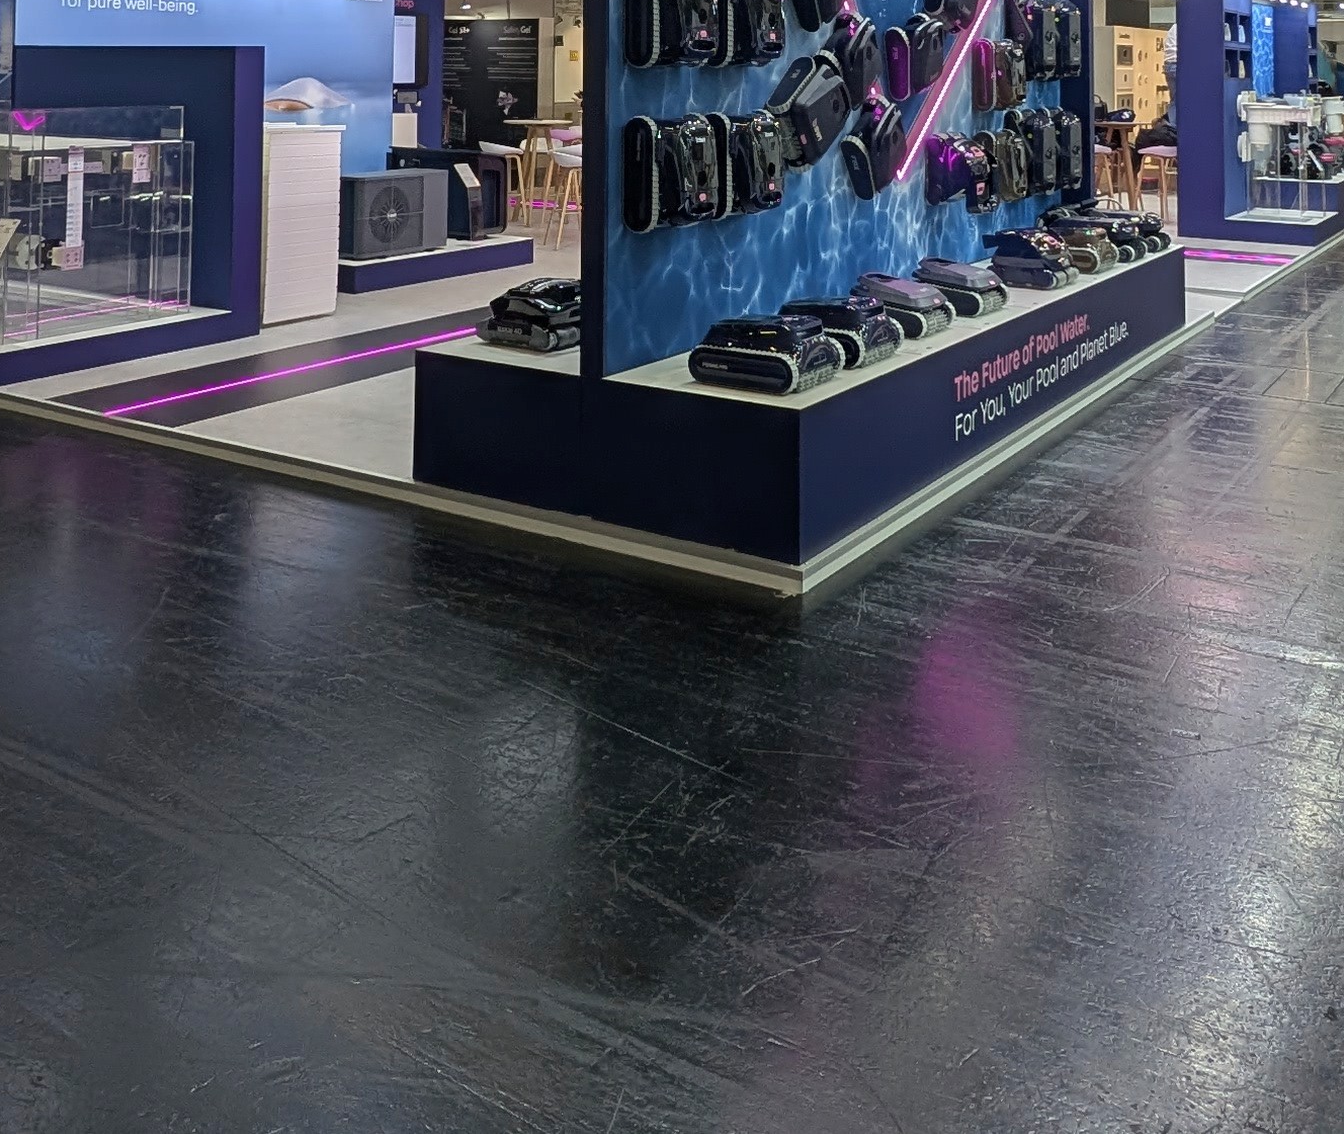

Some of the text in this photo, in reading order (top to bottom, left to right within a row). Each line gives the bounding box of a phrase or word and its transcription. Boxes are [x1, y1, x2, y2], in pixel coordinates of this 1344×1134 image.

[954, 313, 1091, 402] The Future of Pool Water.
[955, 320, 1130, 442] For You, Your Pool and Planet Blue.
